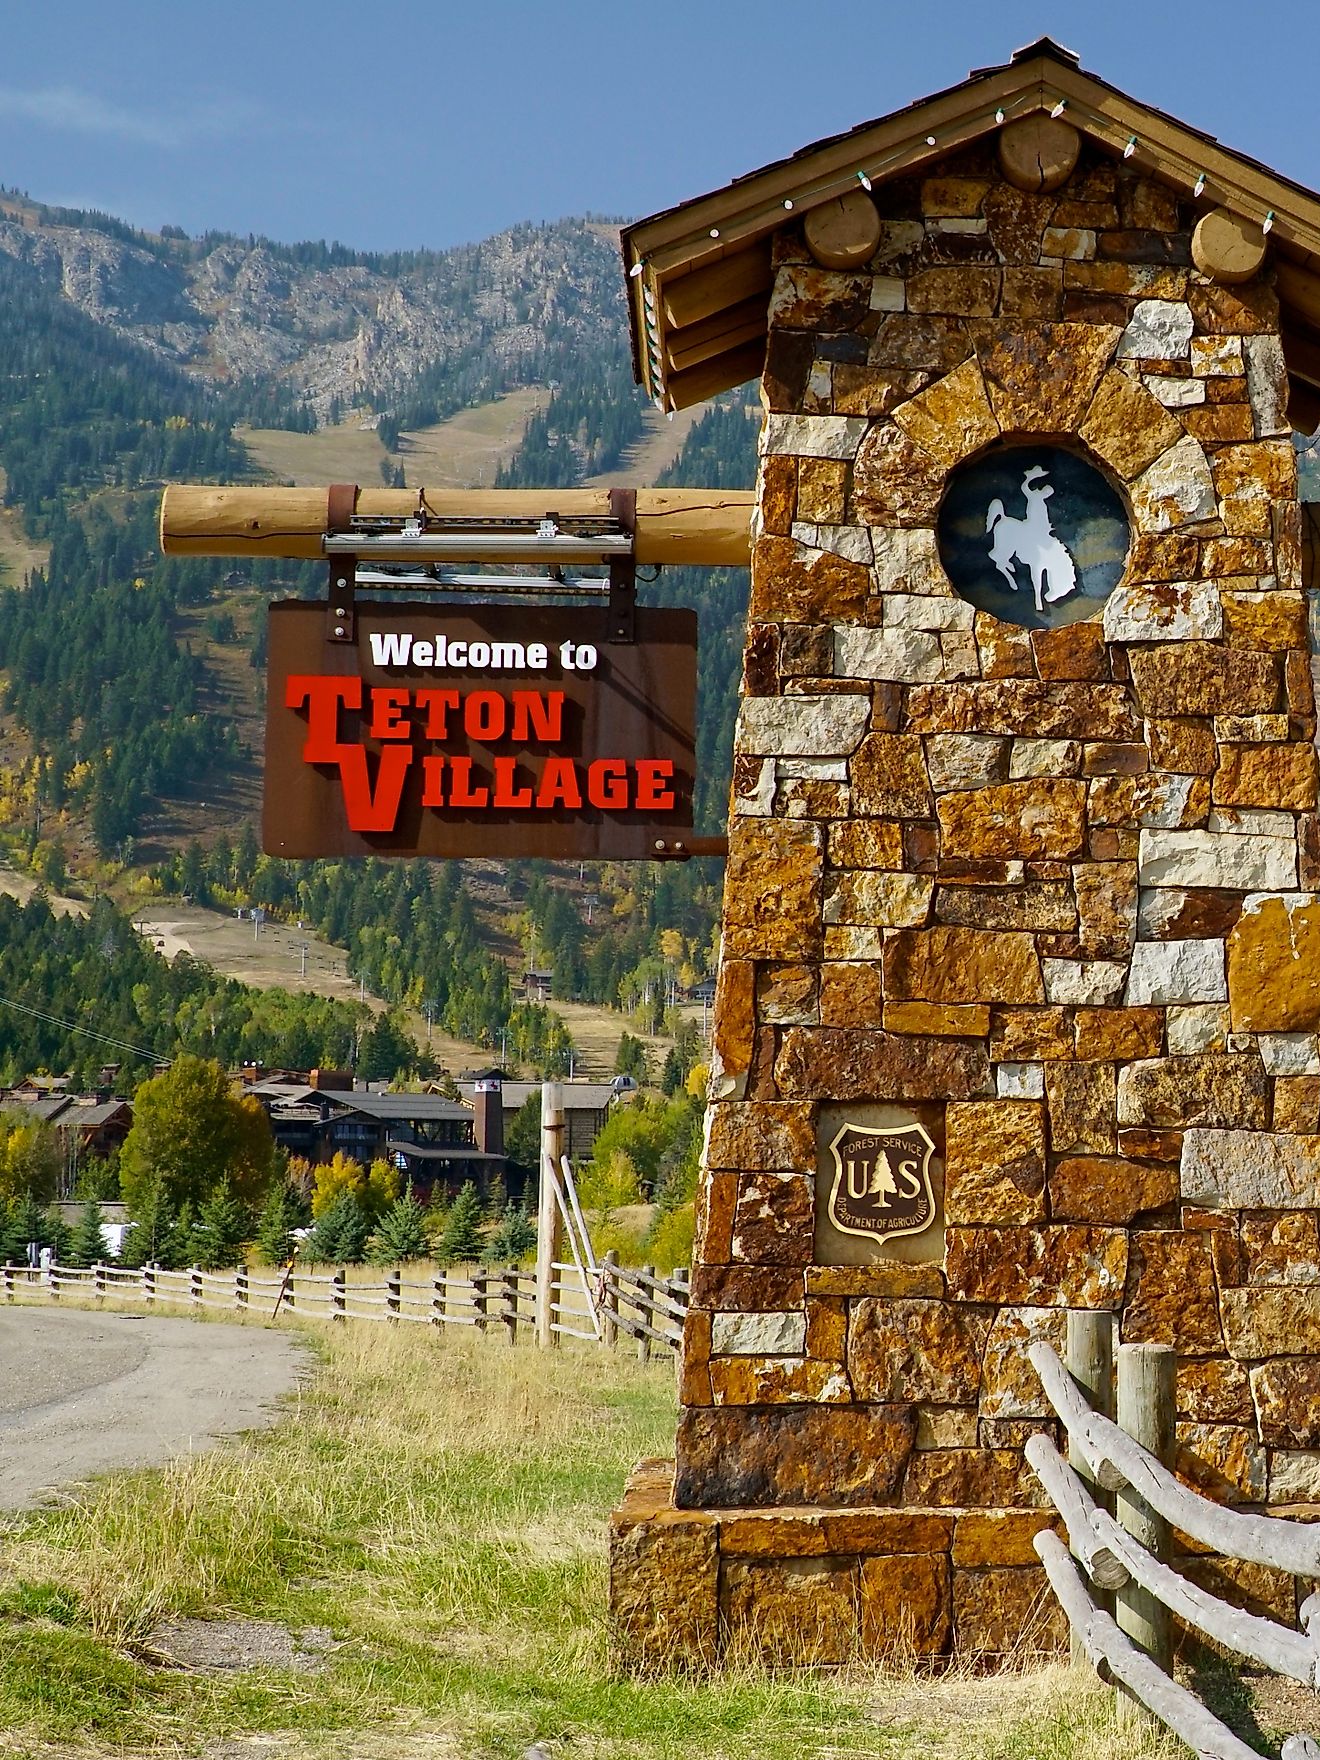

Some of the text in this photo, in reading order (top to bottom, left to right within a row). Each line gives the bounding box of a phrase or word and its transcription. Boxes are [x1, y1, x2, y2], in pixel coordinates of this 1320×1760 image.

[369, 633, 597, 671] Welcome to
[285, 675, 564, 764] TETON
[337, 744, 675, 832] VILLAGE
[843, 1137, 922, 1158] FOREST SERVICE
[847, 1160, 921, 1199] U S
[837, 1197, 927, 1229] DEPARTMENT OF AGRICULTURE
